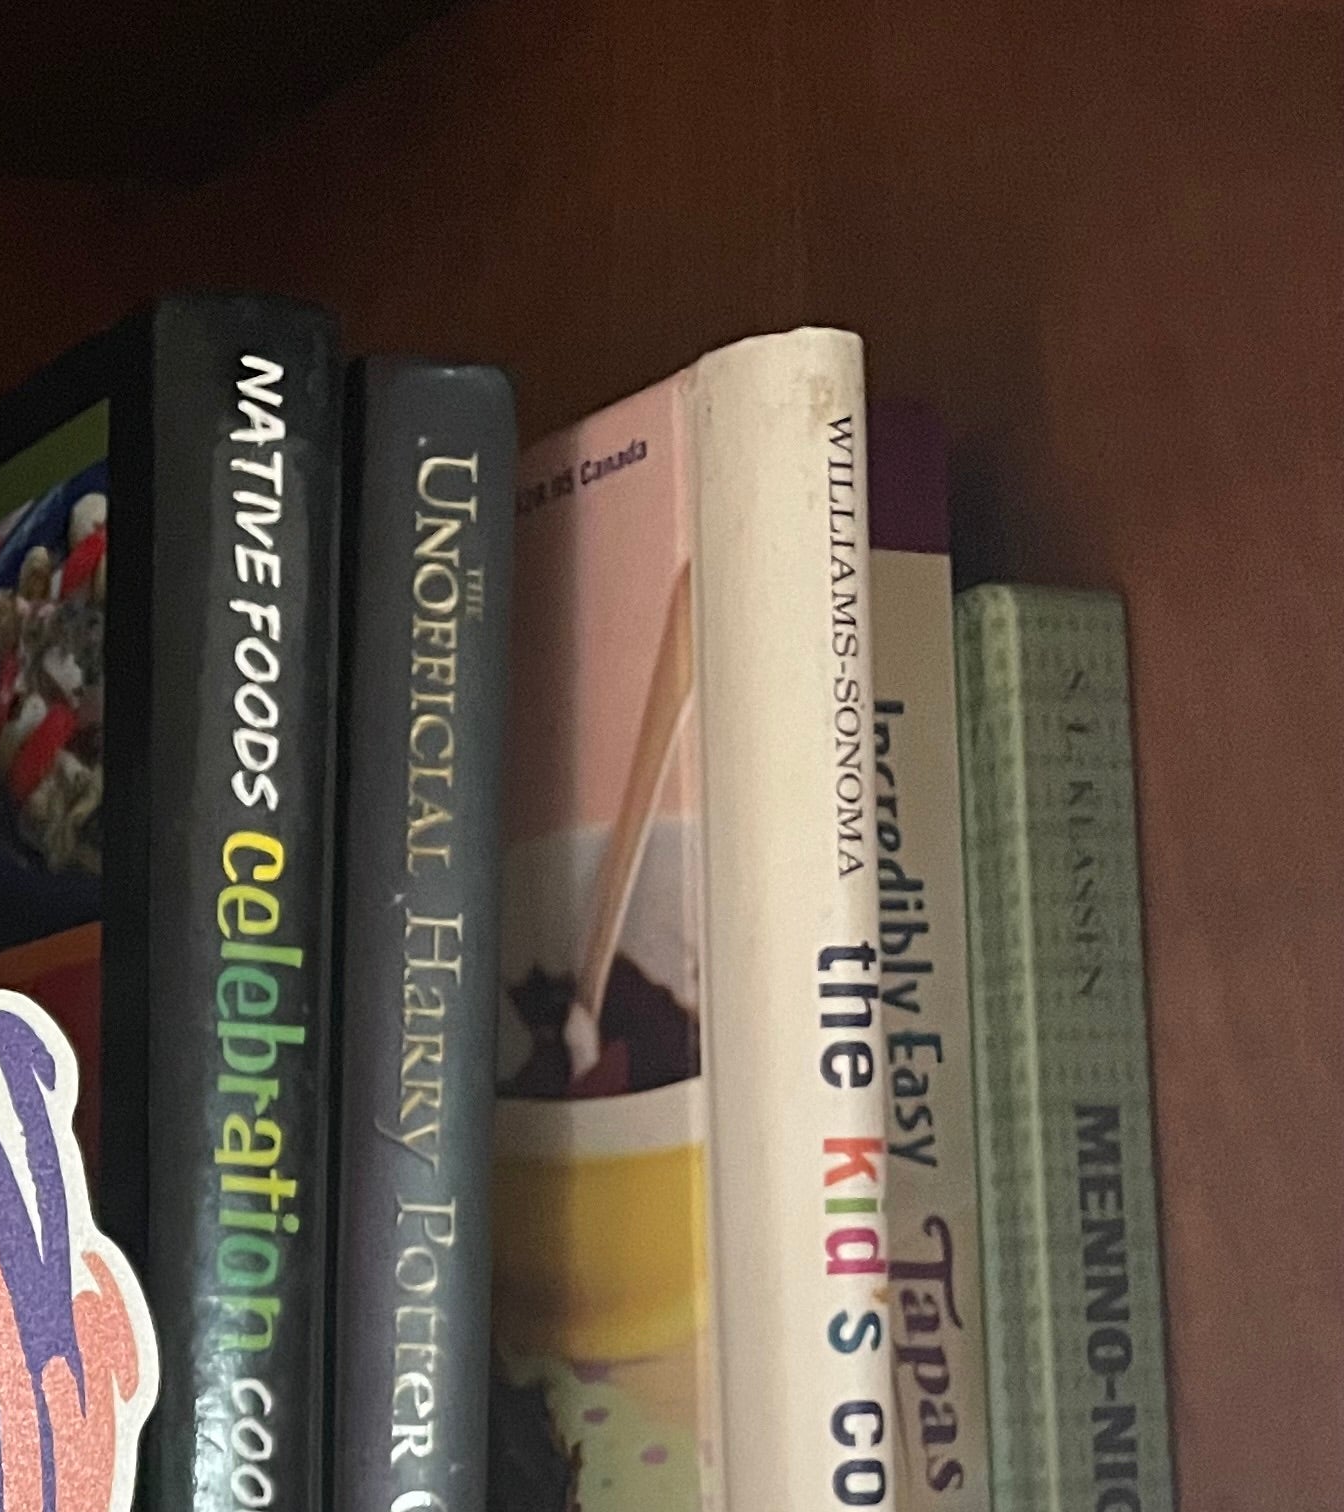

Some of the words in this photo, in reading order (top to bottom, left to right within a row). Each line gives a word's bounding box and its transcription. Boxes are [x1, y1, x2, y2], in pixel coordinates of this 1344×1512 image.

[228, 354, 286, 588] NATIVE
[228, 598, 283, 812] FOODS
[406, 452, 480, 877] UNOFFICIAL
[826, 414, 867, 880] WILLIAMS-SONOMA
[214, 831, 306, 1355] celebration
[817, 940, 880, 1090] the
[887, 1032, 943, 1167] Easy
[889, 1214, 965, 1493] Tapas
